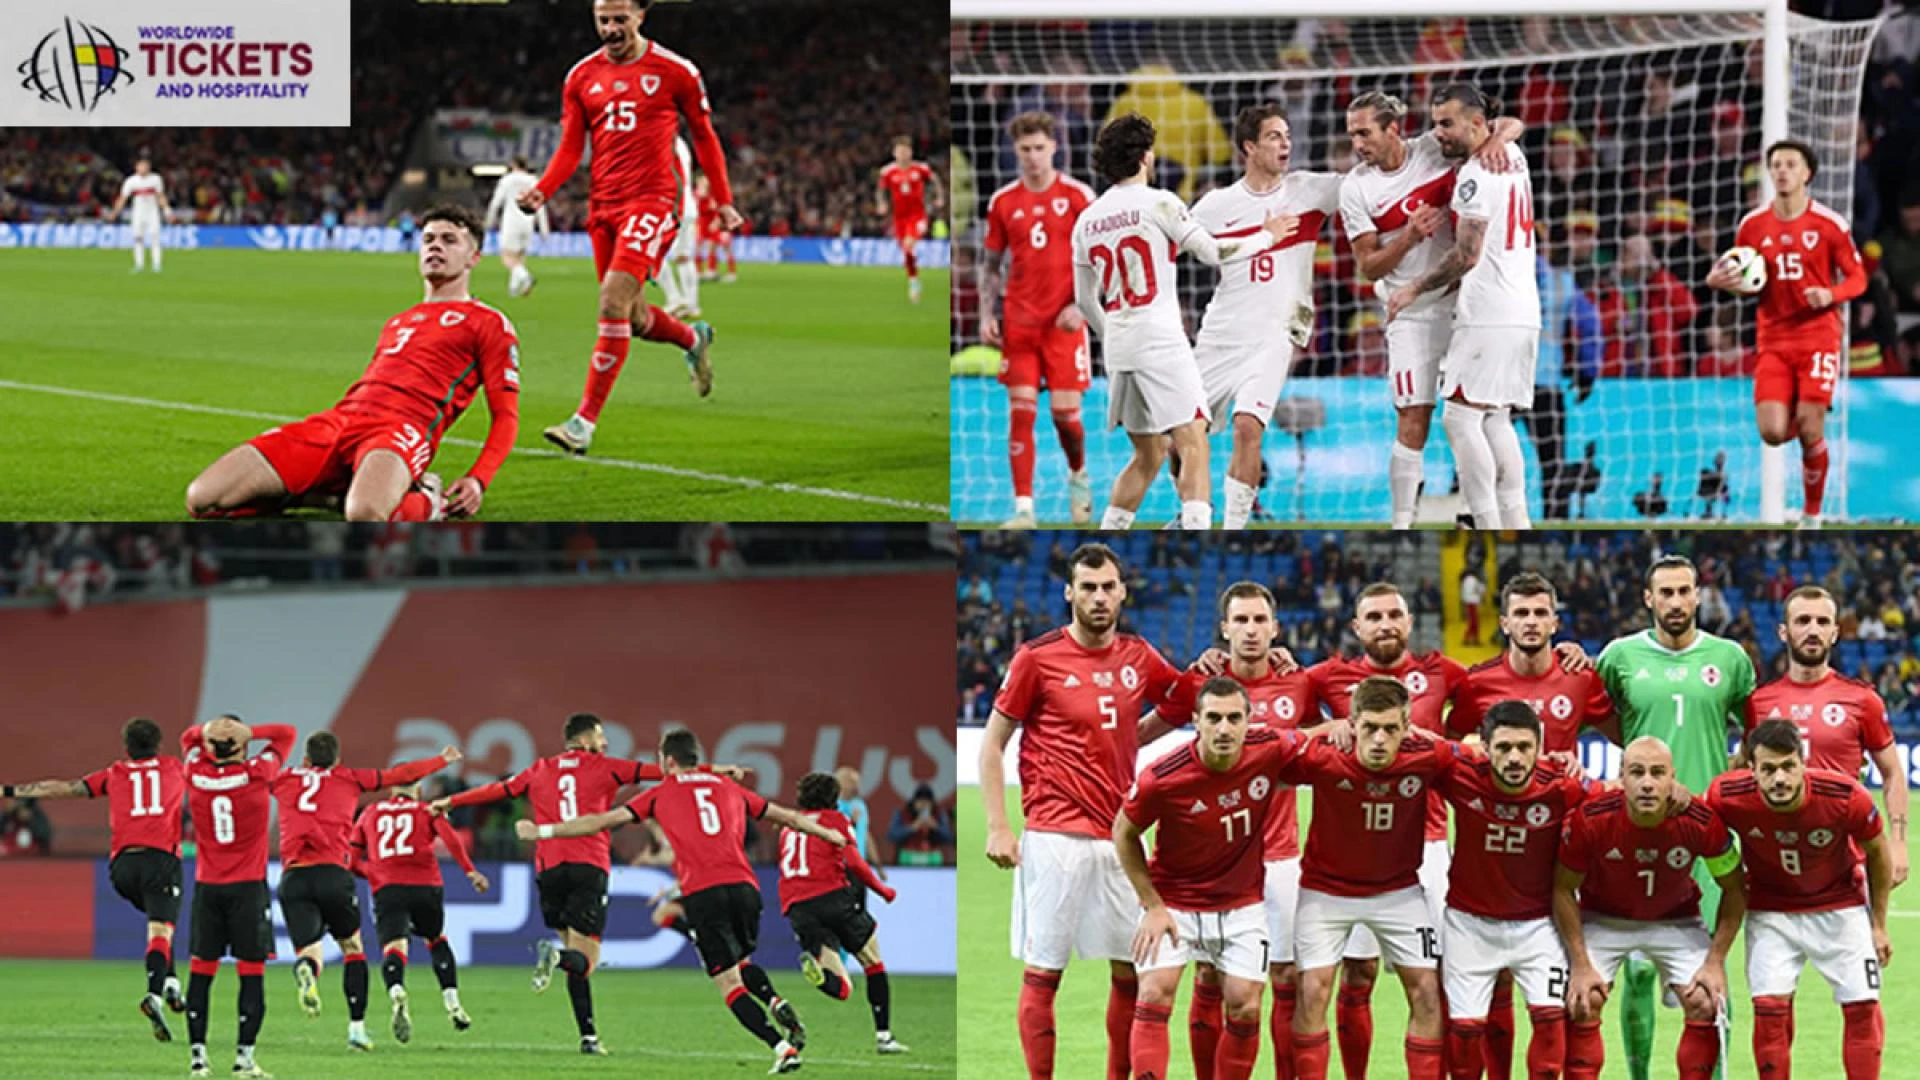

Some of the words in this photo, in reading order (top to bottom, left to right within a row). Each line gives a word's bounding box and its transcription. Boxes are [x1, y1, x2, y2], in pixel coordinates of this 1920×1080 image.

[604, 101, 636, 131] 15
[621, 213, 658, 240] 15
[1030, 221, 1048, 249] 6
[1088, 234, 1158, 313] 20
[1249, 255, 1274, 283] 19
[1775, 253, 1803, 281] 15
[382, 327, 416, 355] 3
[1809, 351, 1837, 379] 15
[1395, 369, 1414, 397] 11
[1098, 696, 1117, 729] 5
[1670, 694, 1685, 727] 1
[129, 769, 165, 816] 11
[299, 772, 321, 812] 2
[558, 774, 577, 822] 3
[211, 795, 235, 844] 6
[694, 788, 721, 835] 5
[1219, 808, 1251, 843] 17
[1361, 802, 1394, 831] 18
[377, 812, 415, 859] 22
[1484, 823, 1527, 854] 22
[782, 830, 810, 878] 21
[1779, 848, 1801, 876] 8
[1637, 869, 1656, 897] 7
[1549, 967, 1570, 999] 2
[1864, 959, 1881, 989] 8
